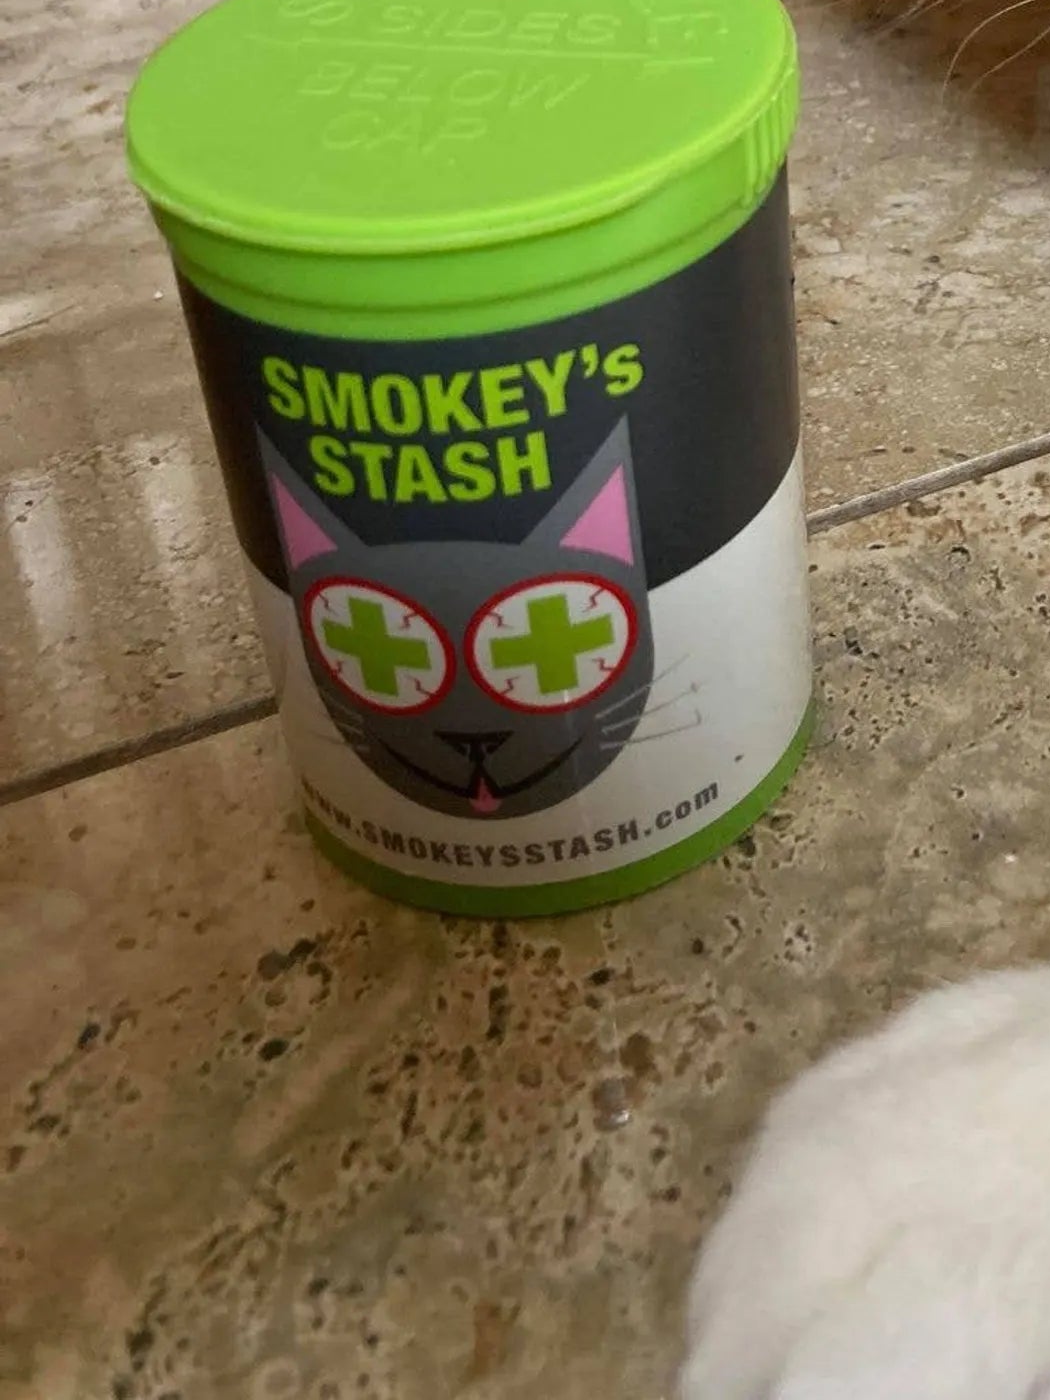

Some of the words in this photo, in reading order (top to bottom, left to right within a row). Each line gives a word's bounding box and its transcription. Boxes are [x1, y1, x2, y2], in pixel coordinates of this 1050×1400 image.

[376, 5, 622, 46] SIDES
[298, 61, 591, 109] BELOW
[322, 110, 488, 155] CAP
[262, 343, 644, 436] SMOKEY's
[309, 431, 552, 504] STASH
